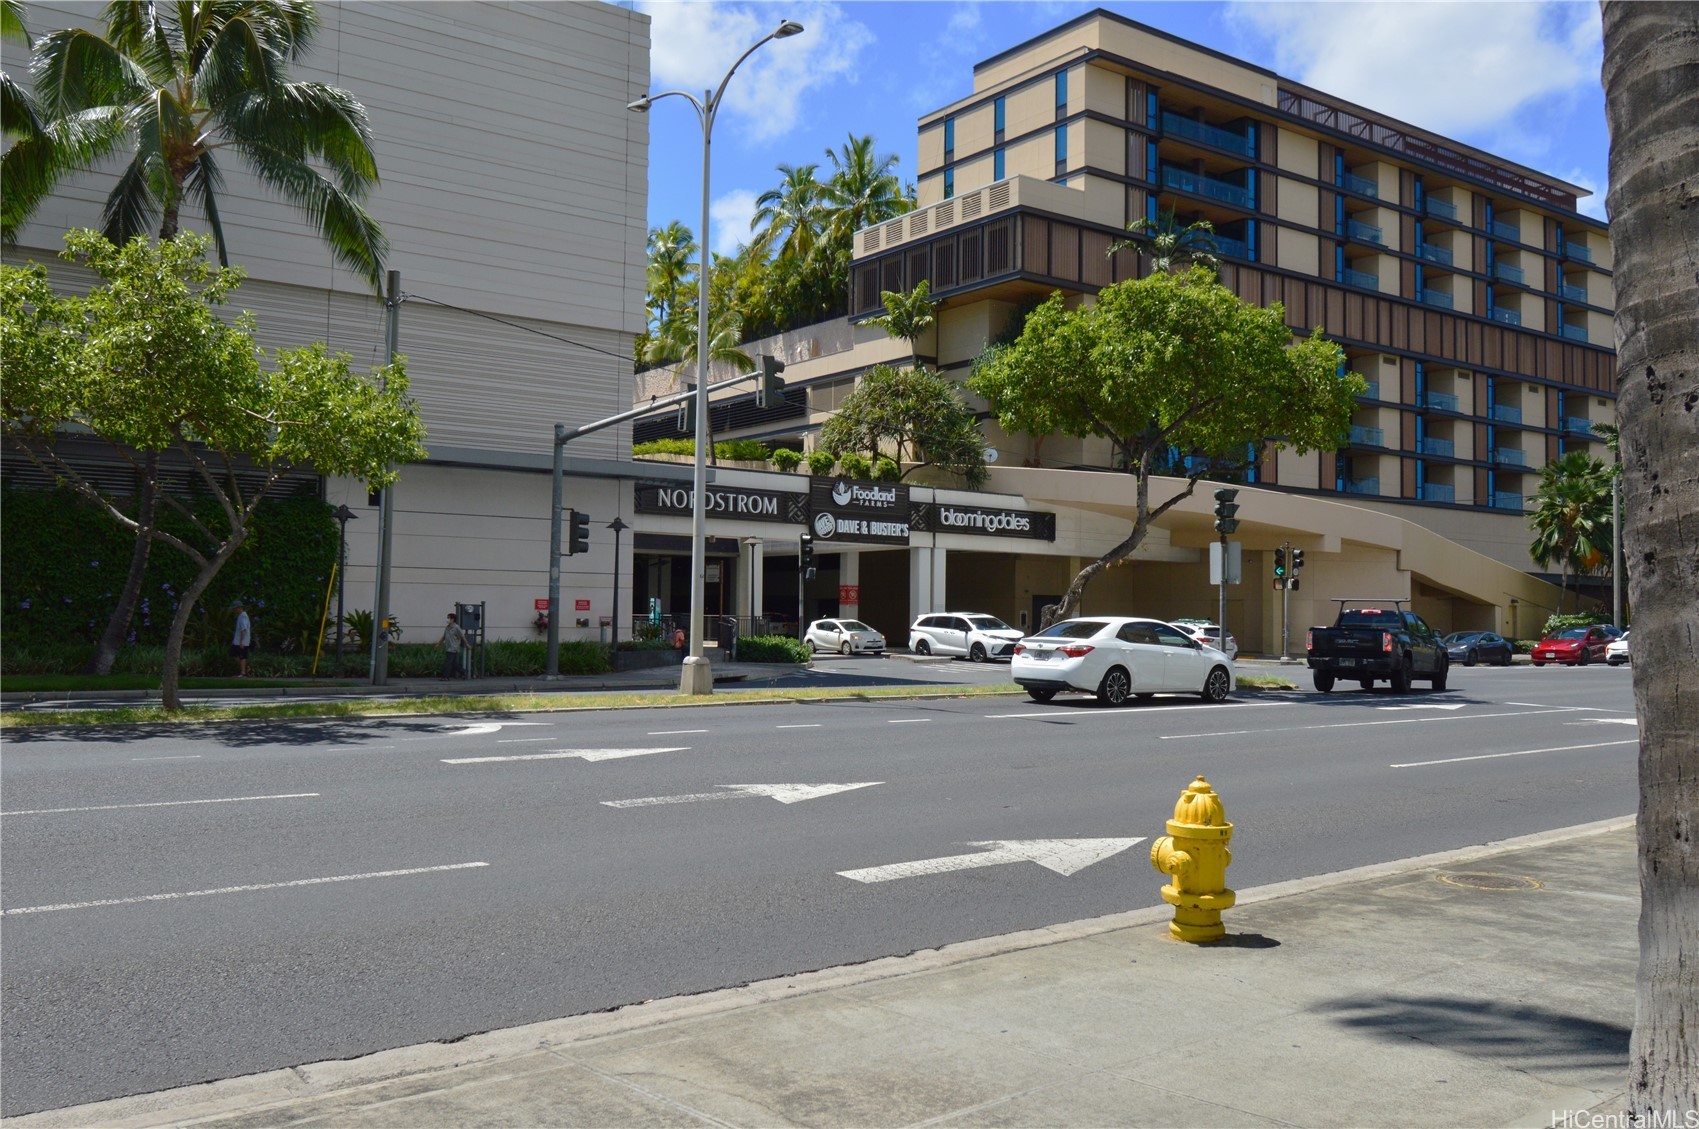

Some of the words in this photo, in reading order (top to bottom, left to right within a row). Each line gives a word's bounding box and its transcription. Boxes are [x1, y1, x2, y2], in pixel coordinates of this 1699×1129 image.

[852, 485, 896, 502] Foodland
[860, 500, 888, 508] FARMS
[836, 519, 860, 534] DAVE
[860, 520, 869, 535] &
[870, 521, 909, 537] BUSTER'S
